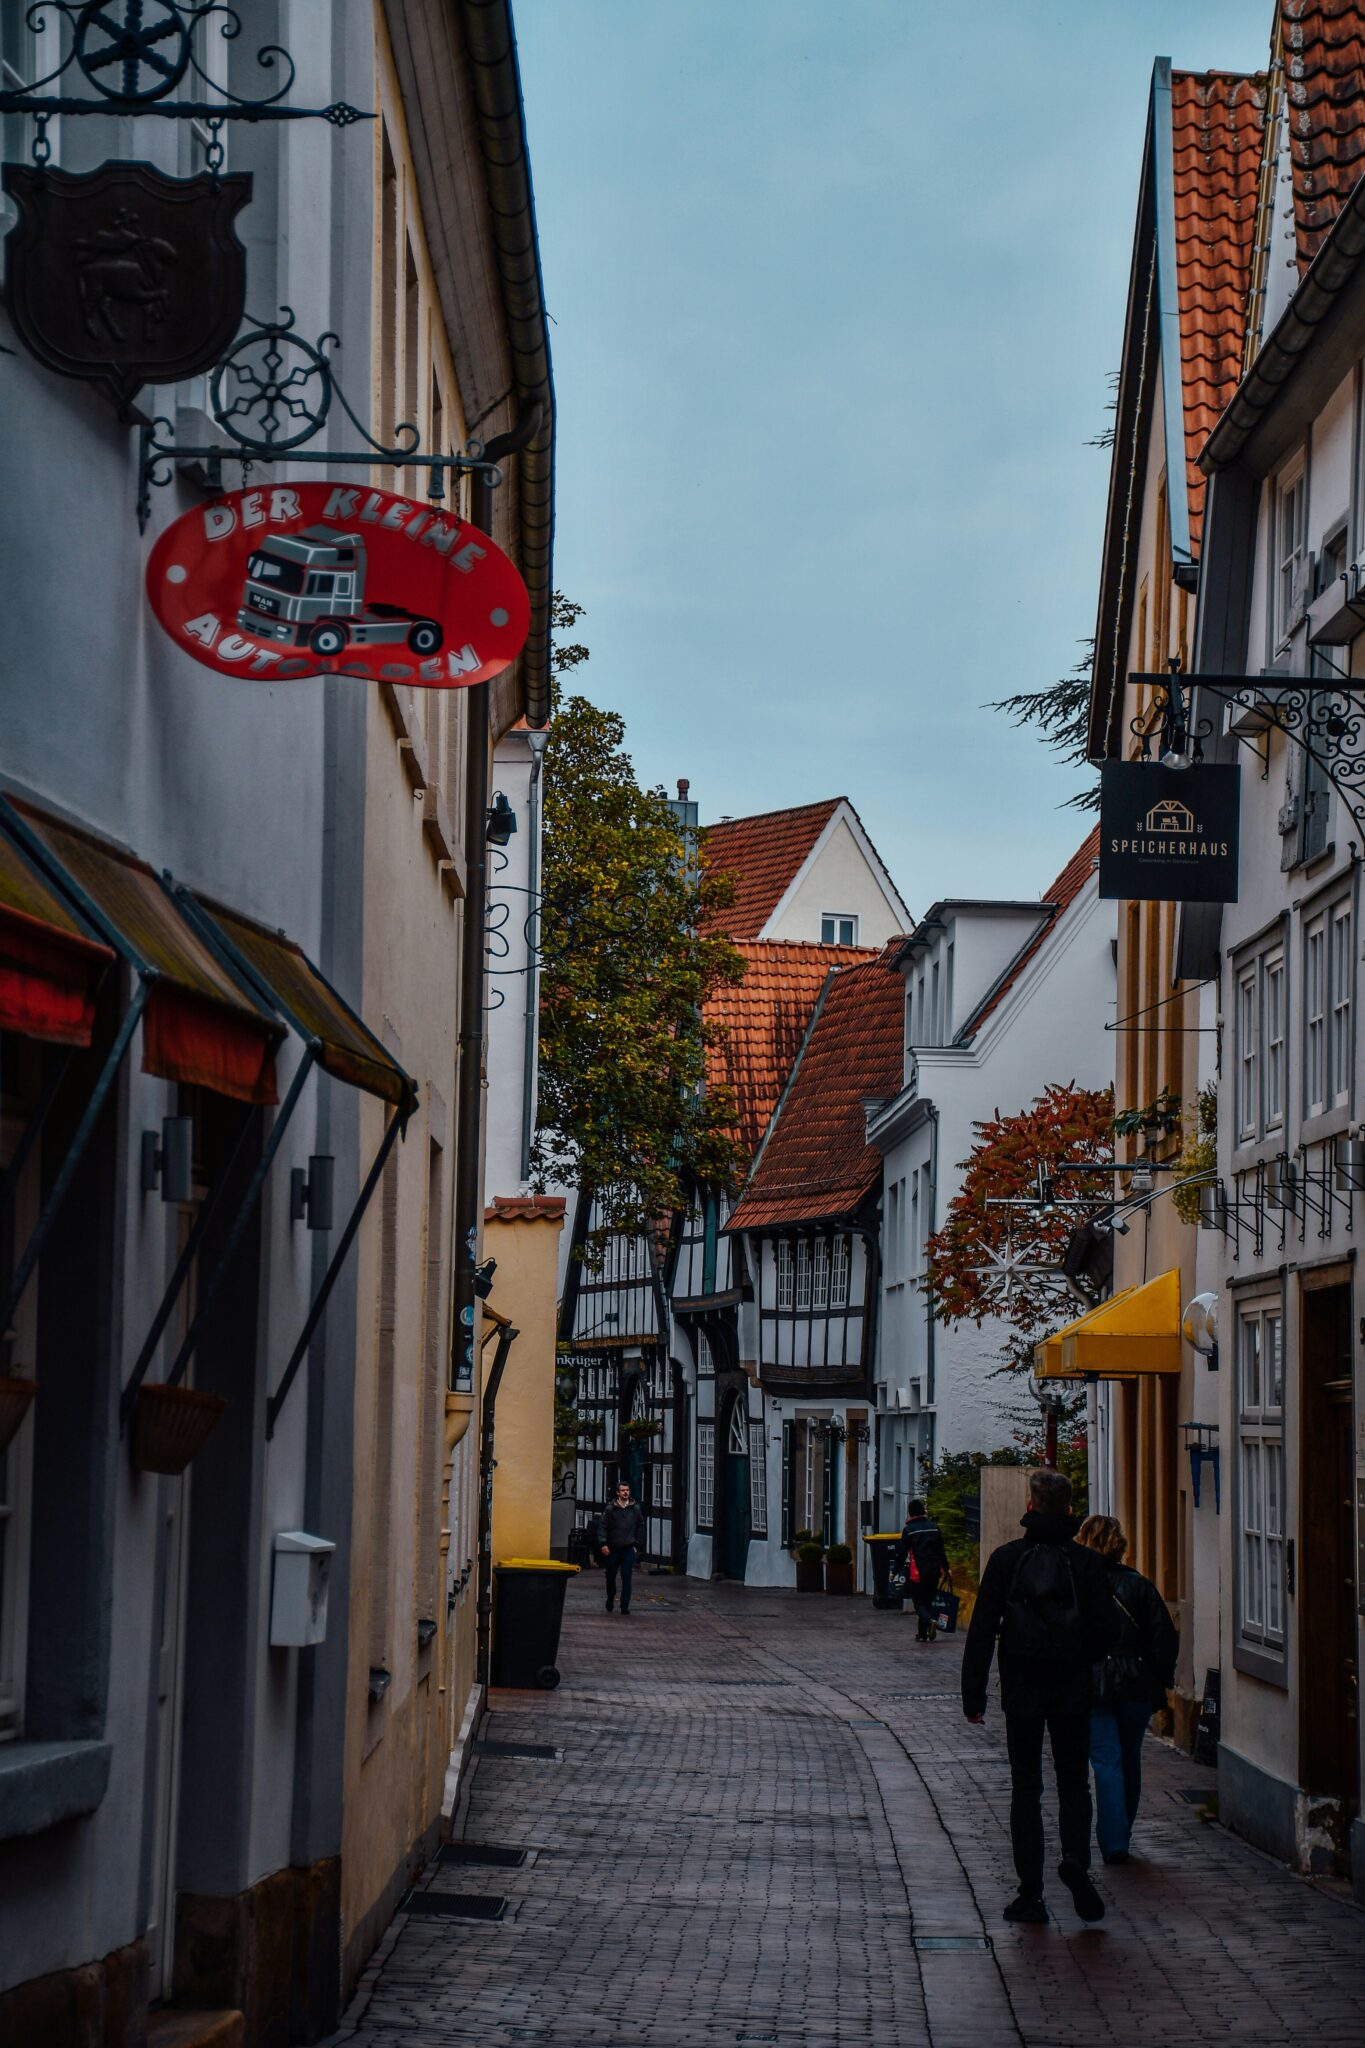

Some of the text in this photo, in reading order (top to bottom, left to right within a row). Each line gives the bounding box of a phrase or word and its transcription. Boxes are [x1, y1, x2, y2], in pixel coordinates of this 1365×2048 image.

[202, 488, 487, 573] DER KLEINE
[253, 594, 273, 607] MAN
[1111, 839, 1228, 856] SPEICHERHAUS
[557, 1355, 602, 1367] nkrüger
